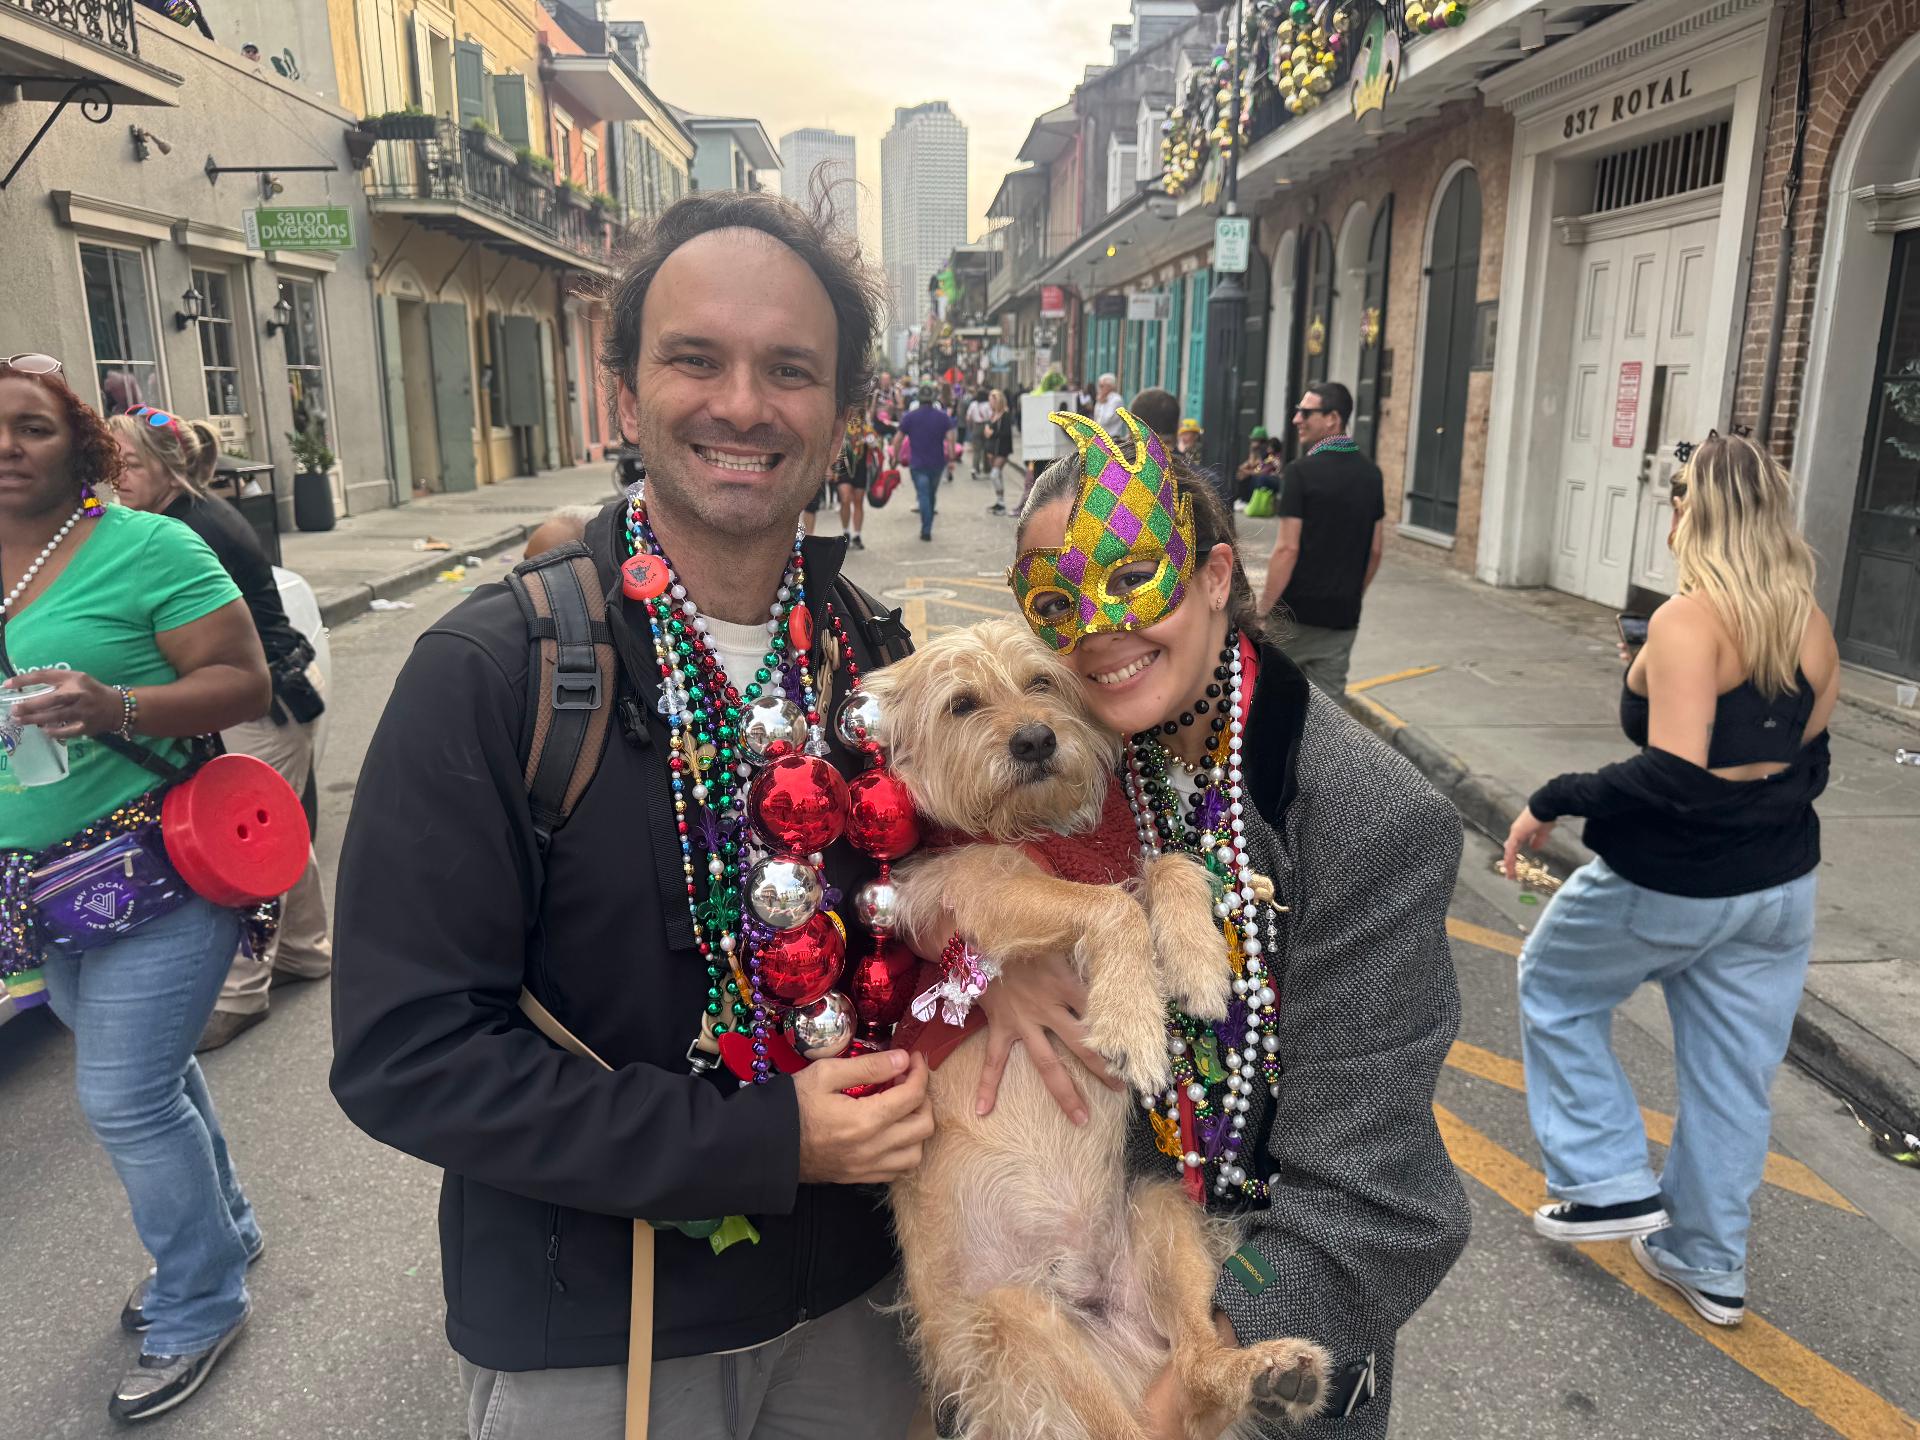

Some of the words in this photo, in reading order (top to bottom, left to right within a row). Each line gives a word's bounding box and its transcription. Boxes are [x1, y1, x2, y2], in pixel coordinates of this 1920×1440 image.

[1563, 104, 1599, 139] 837
[1611, 68, 1692, 122] ROYAL
[73, 890, 87, 911] VERY
[91, 881, 124, 891] LOCAL
[86, 921, 106, 930] NEW
[108, 899, 135, 929] ORLEANS
